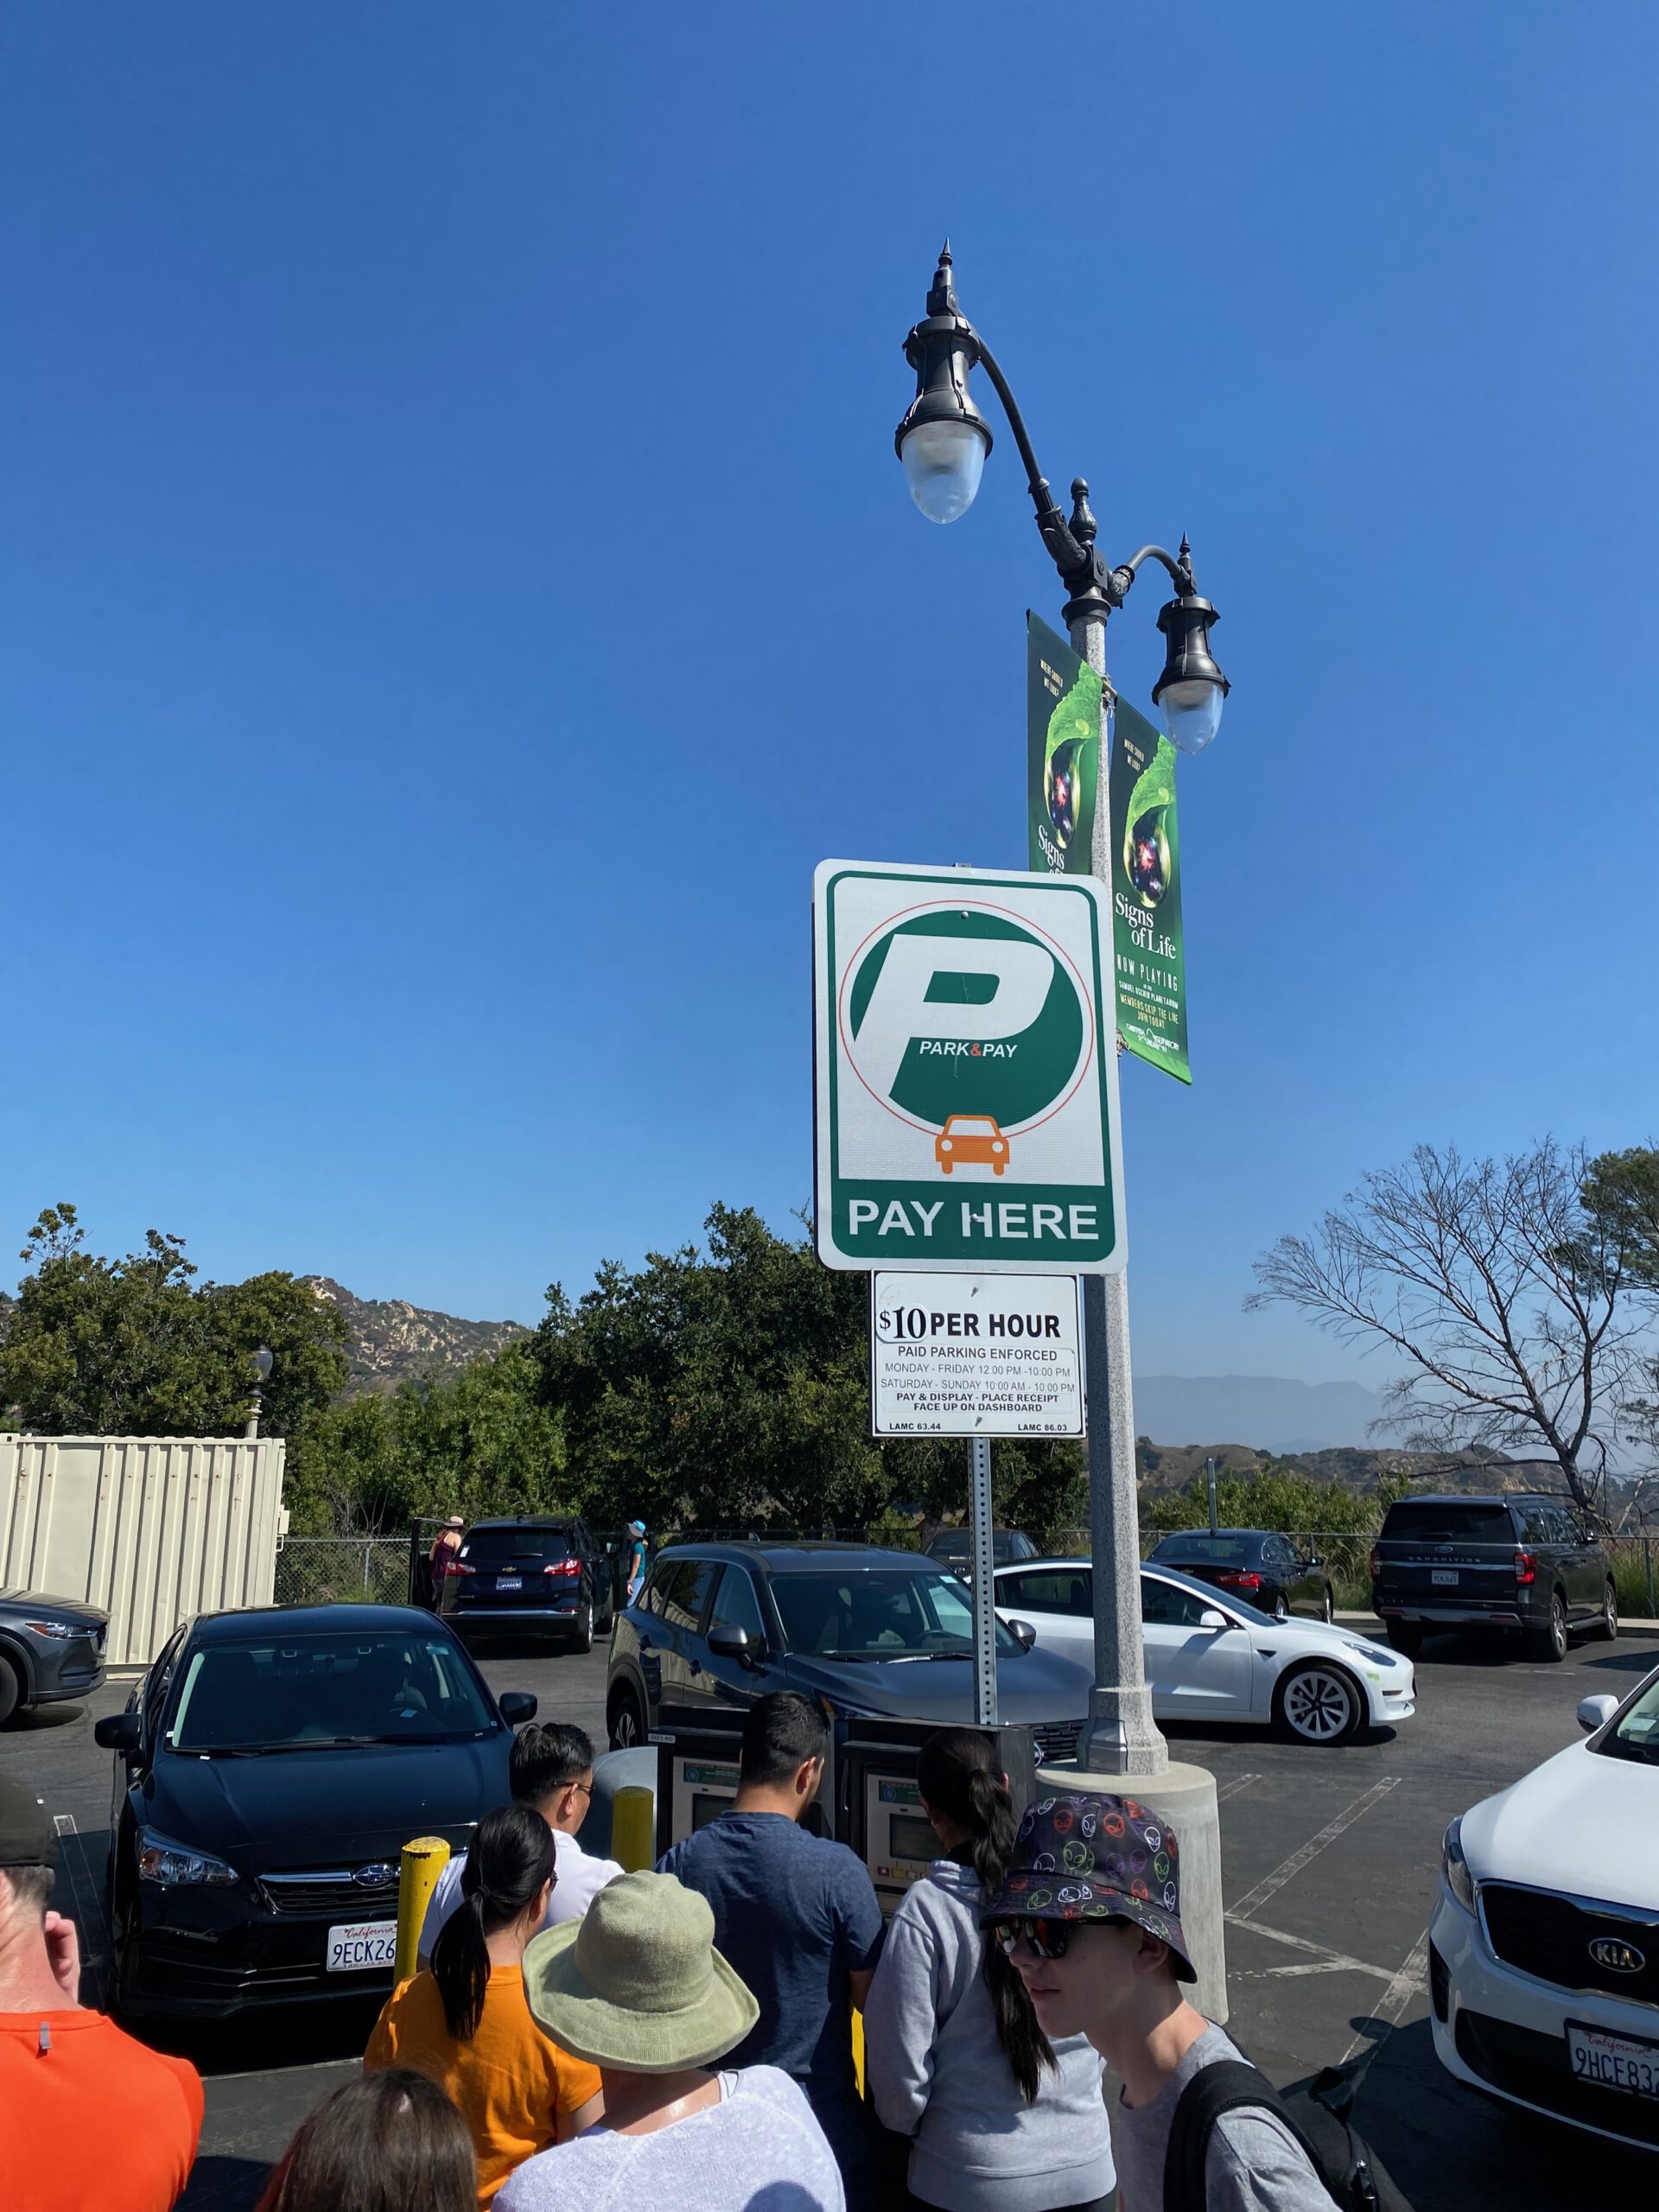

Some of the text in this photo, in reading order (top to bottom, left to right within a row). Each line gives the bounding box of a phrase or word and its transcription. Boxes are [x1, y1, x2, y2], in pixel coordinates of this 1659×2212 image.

[1038, 824, 1065, 869] Signs
[1116, 892, 1154, 928] Signs
[1131, 927, 1176, 959] of Life
[1116, 954, 1178, 992] NOW PLAYING
[1120, 993, 1144, 1011] MEMBERS
[1144, 1002, 1156, 1015] SKIP
[919, 1040, 1018, 1058] PARK&PAY
[849, 1199, 1099, 1240] PAY HERE
[879, 1306, 1061, 1339] $10 PER HOUR
[898, 1346, 1058, 1361] PAID PARKING ENFORCED
[885, 1363, 930, 1373] MONDAY
[938, 1363, 975, 1374] FRIDAY
[1006, 1366, 1021, 1376] PM
[1056, 1368, 1070, 1377] PM
[881, 1379, 933, 1389] SATURDAY
[942, 1379, 982, 1389] SUNDAY
[1011, 1382, 1025, 1391] AM
[1061, 1383, 1075, 1393] PM
[930, 1393, 973, 1402] DISPLAY
[982, 1393, 1014, 1402] PLACE
[1016, 1395, 1059, 1403] RECEIPT
[978, 1403, 1042, 1412] DASHBOARD
[346, 1927, 397, 1939] California
[1597, 1942, 1636, 1968] KIA
[1588, 2032, 1649, 2056] California
